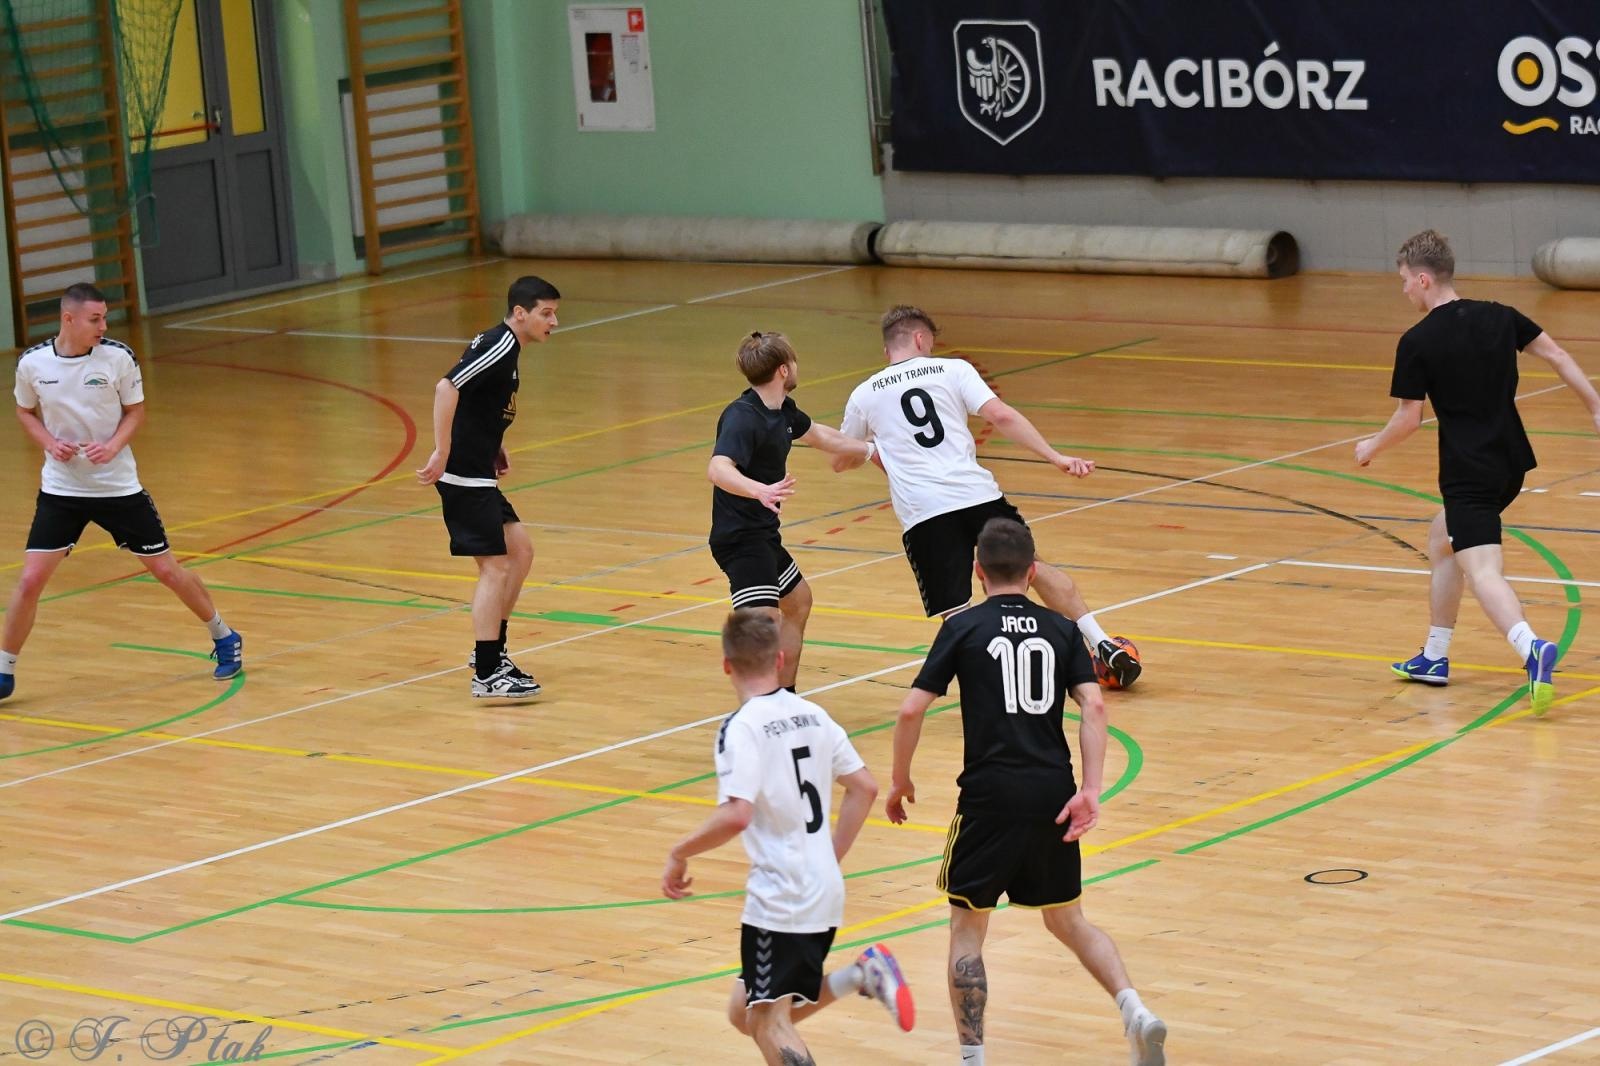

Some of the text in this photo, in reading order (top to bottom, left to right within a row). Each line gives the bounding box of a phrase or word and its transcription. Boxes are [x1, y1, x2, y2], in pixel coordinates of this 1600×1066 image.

[1092, 40, 1369, 111] RACIBÓRZ
[1497, 36, 1600, 108] OS
[872, 365, 945, 392] PIĘKNY TRAWNIK
[900, 387, 945, 449] 9
[1001, 615, 1038, 633] JACO
[986, 636, 1056, 715] 10
[791, 745, 824, 834] 5
